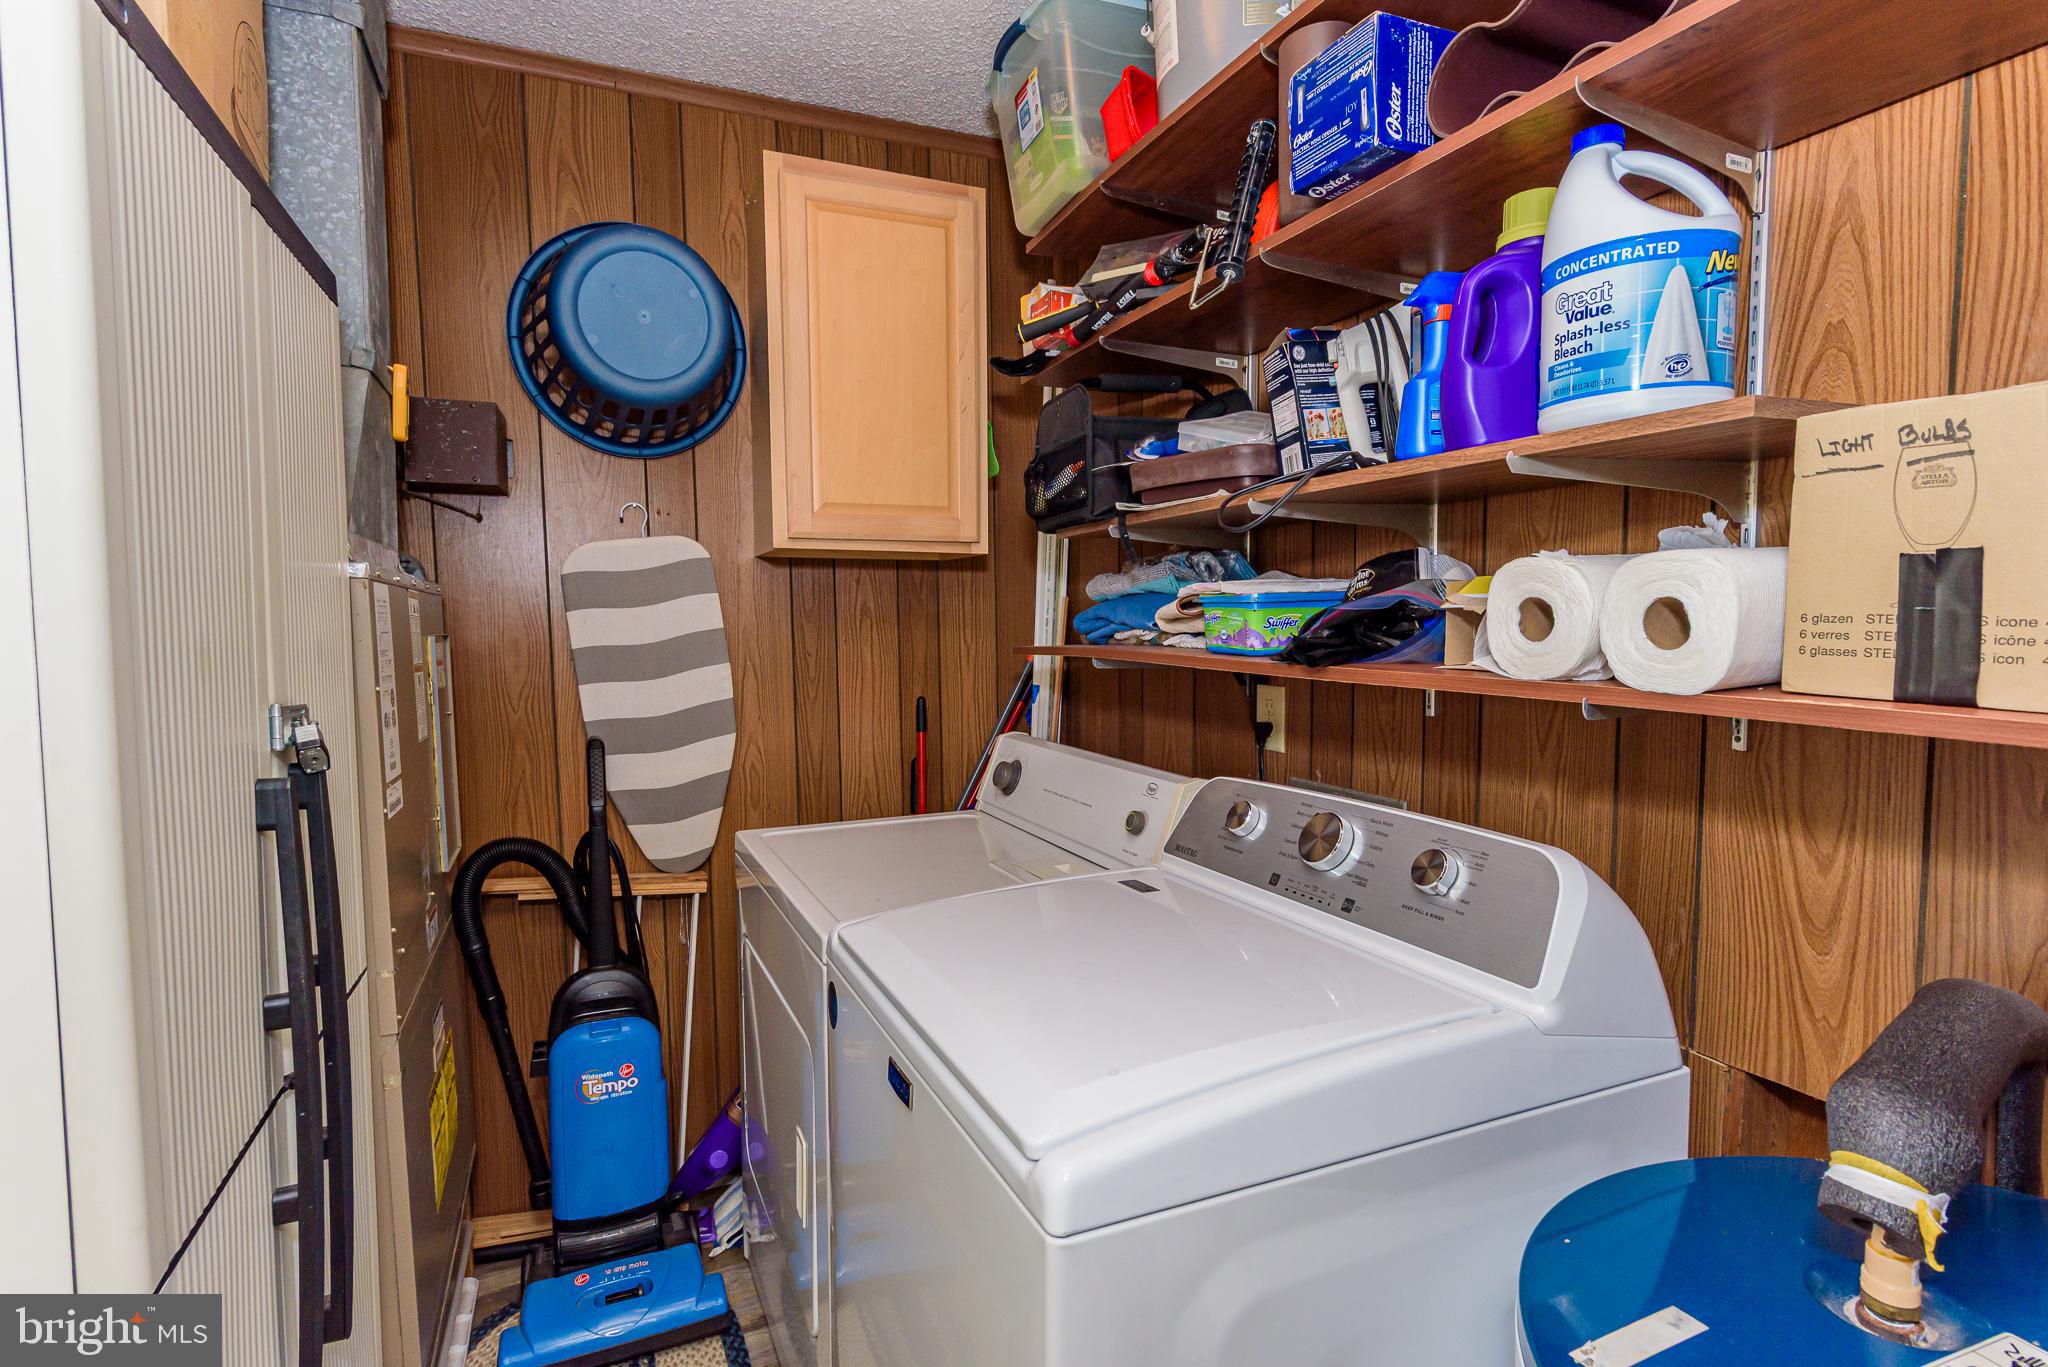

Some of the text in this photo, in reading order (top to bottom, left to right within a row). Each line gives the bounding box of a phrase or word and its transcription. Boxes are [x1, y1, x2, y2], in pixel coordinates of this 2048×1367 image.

[1345, 100, 1358, 116] JOY
[1386, 82, 1403, 140] Oster
[1293, 128, 1315, 149] Oster
[1308, 173, 1351, 198] Oster
[1555, 240, 1681, 281] CONCENTRATED
[1117, 289, 1137, 309] TWIST
[1556, 280, 1613, 315] Great
[1092, 311, 1114, 331] REACH
[1565, 302, 1613, 325] Value
[1554, 319, 1631, 347] Splash-less
[1554, 342, 1593, 361] Bleach
[1817, 418, 1972, 457] LIGHT BULBS
[1263, 616, 1300, 630] Swiffer
[1800, 613, 1808, 623] 6
[1811, 613, 1854, 626] glazen
[1996, 615, 2039, 628] icone
[1799, 629, 1807, 639] 6
[1810, 631, 1850, 640] verres
[1994, 634, 2037, 647] icône
[1799, 645, 1806, 655] 6
[1809, 645, 1857, 658] glasses
[1993, 653, 2025, 665] icon
[581, 1071, 614, 1080] Widepath
[582, 1077, 639, 1096] Tempo
[628, 1261, 649, 1270] motor
